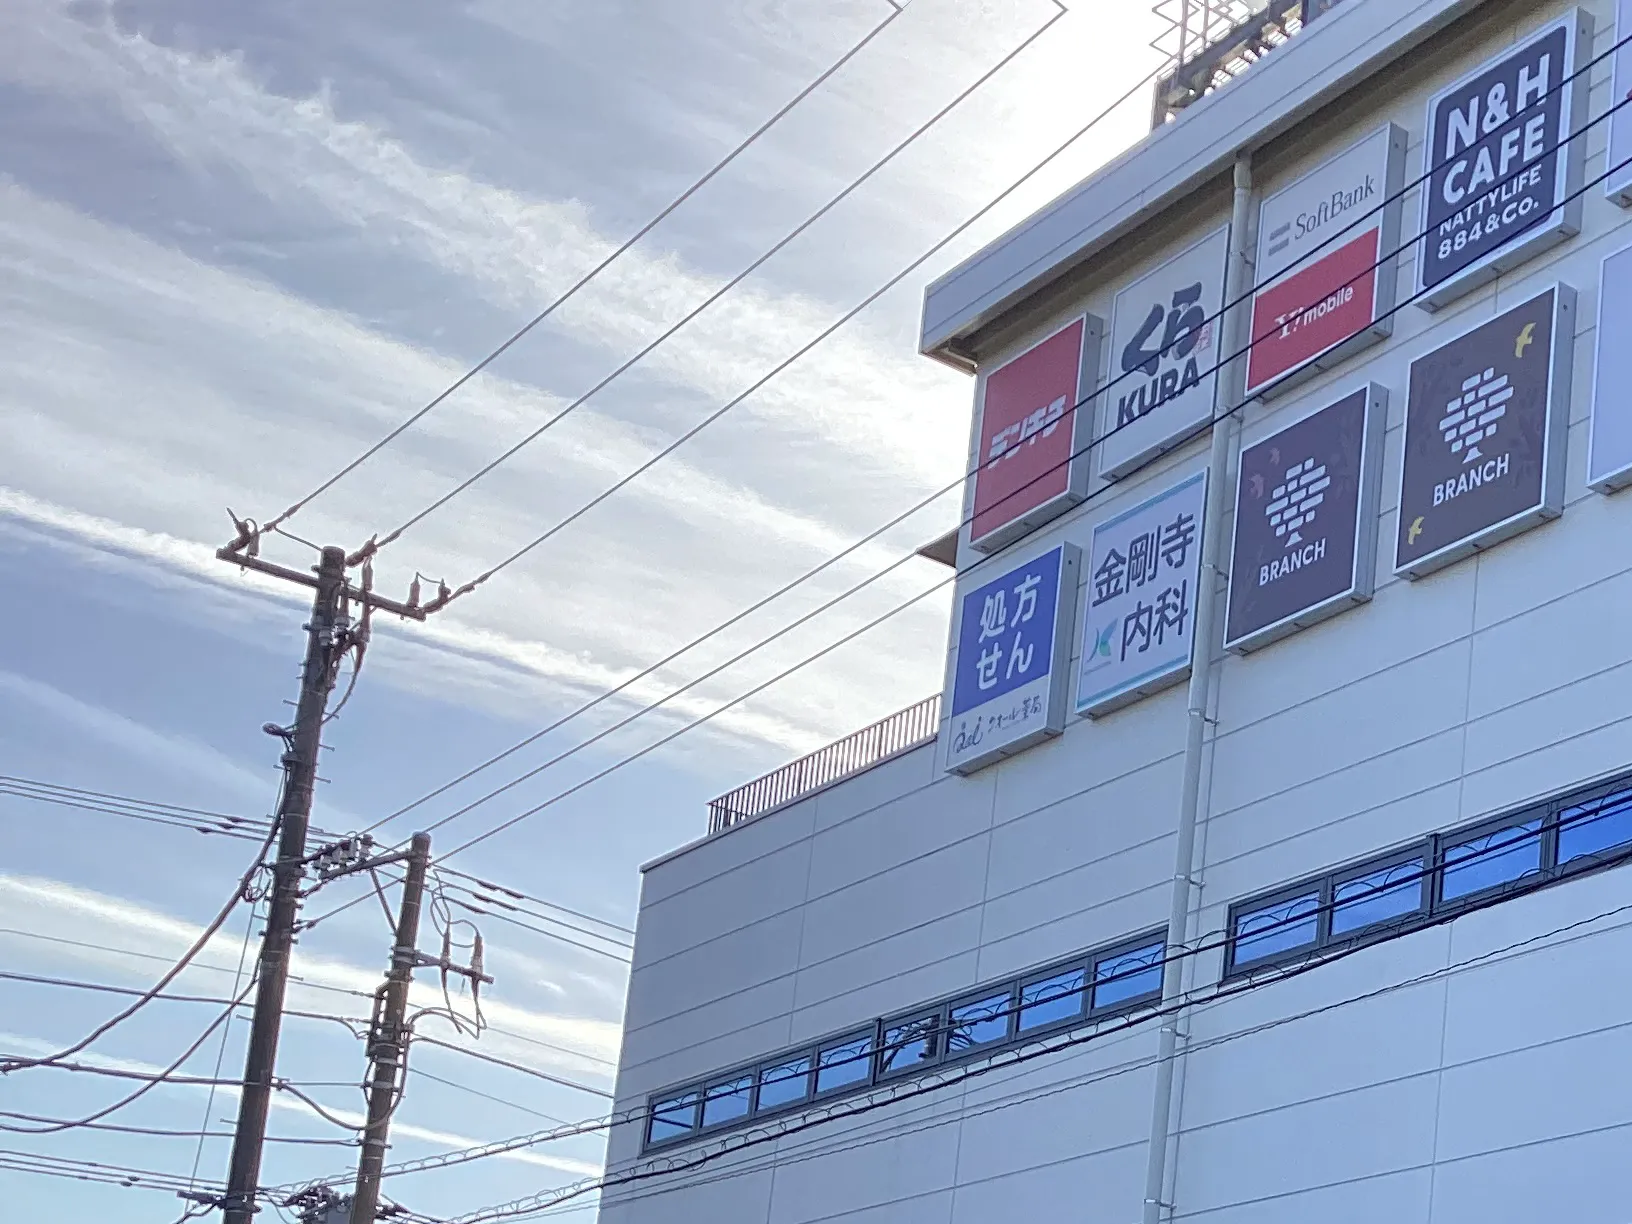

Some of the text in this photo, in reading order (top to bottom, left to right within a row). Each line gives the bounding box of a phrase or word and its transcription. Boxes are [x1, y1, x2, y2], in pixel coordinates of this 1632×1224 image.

[1445, 53, 1550, 159] N&H
[1443, 112, 1546, 204] CAFE
[1294, 175, 1375, 240] SoftBank
[1121, 281, 1205, 376] くら
[1117, 356, 1200, 428] KURA
[1432, 453, 1509, 507] BRANCH
[1092, 513, 1196, 607] 金剛寺
[1258, 538, 1326, 586] BRANCH
[979, 574, 1042, 643] 処方
[1120, 580, 1189, 661] 内科
[976, 632, 1034, 690] せん
